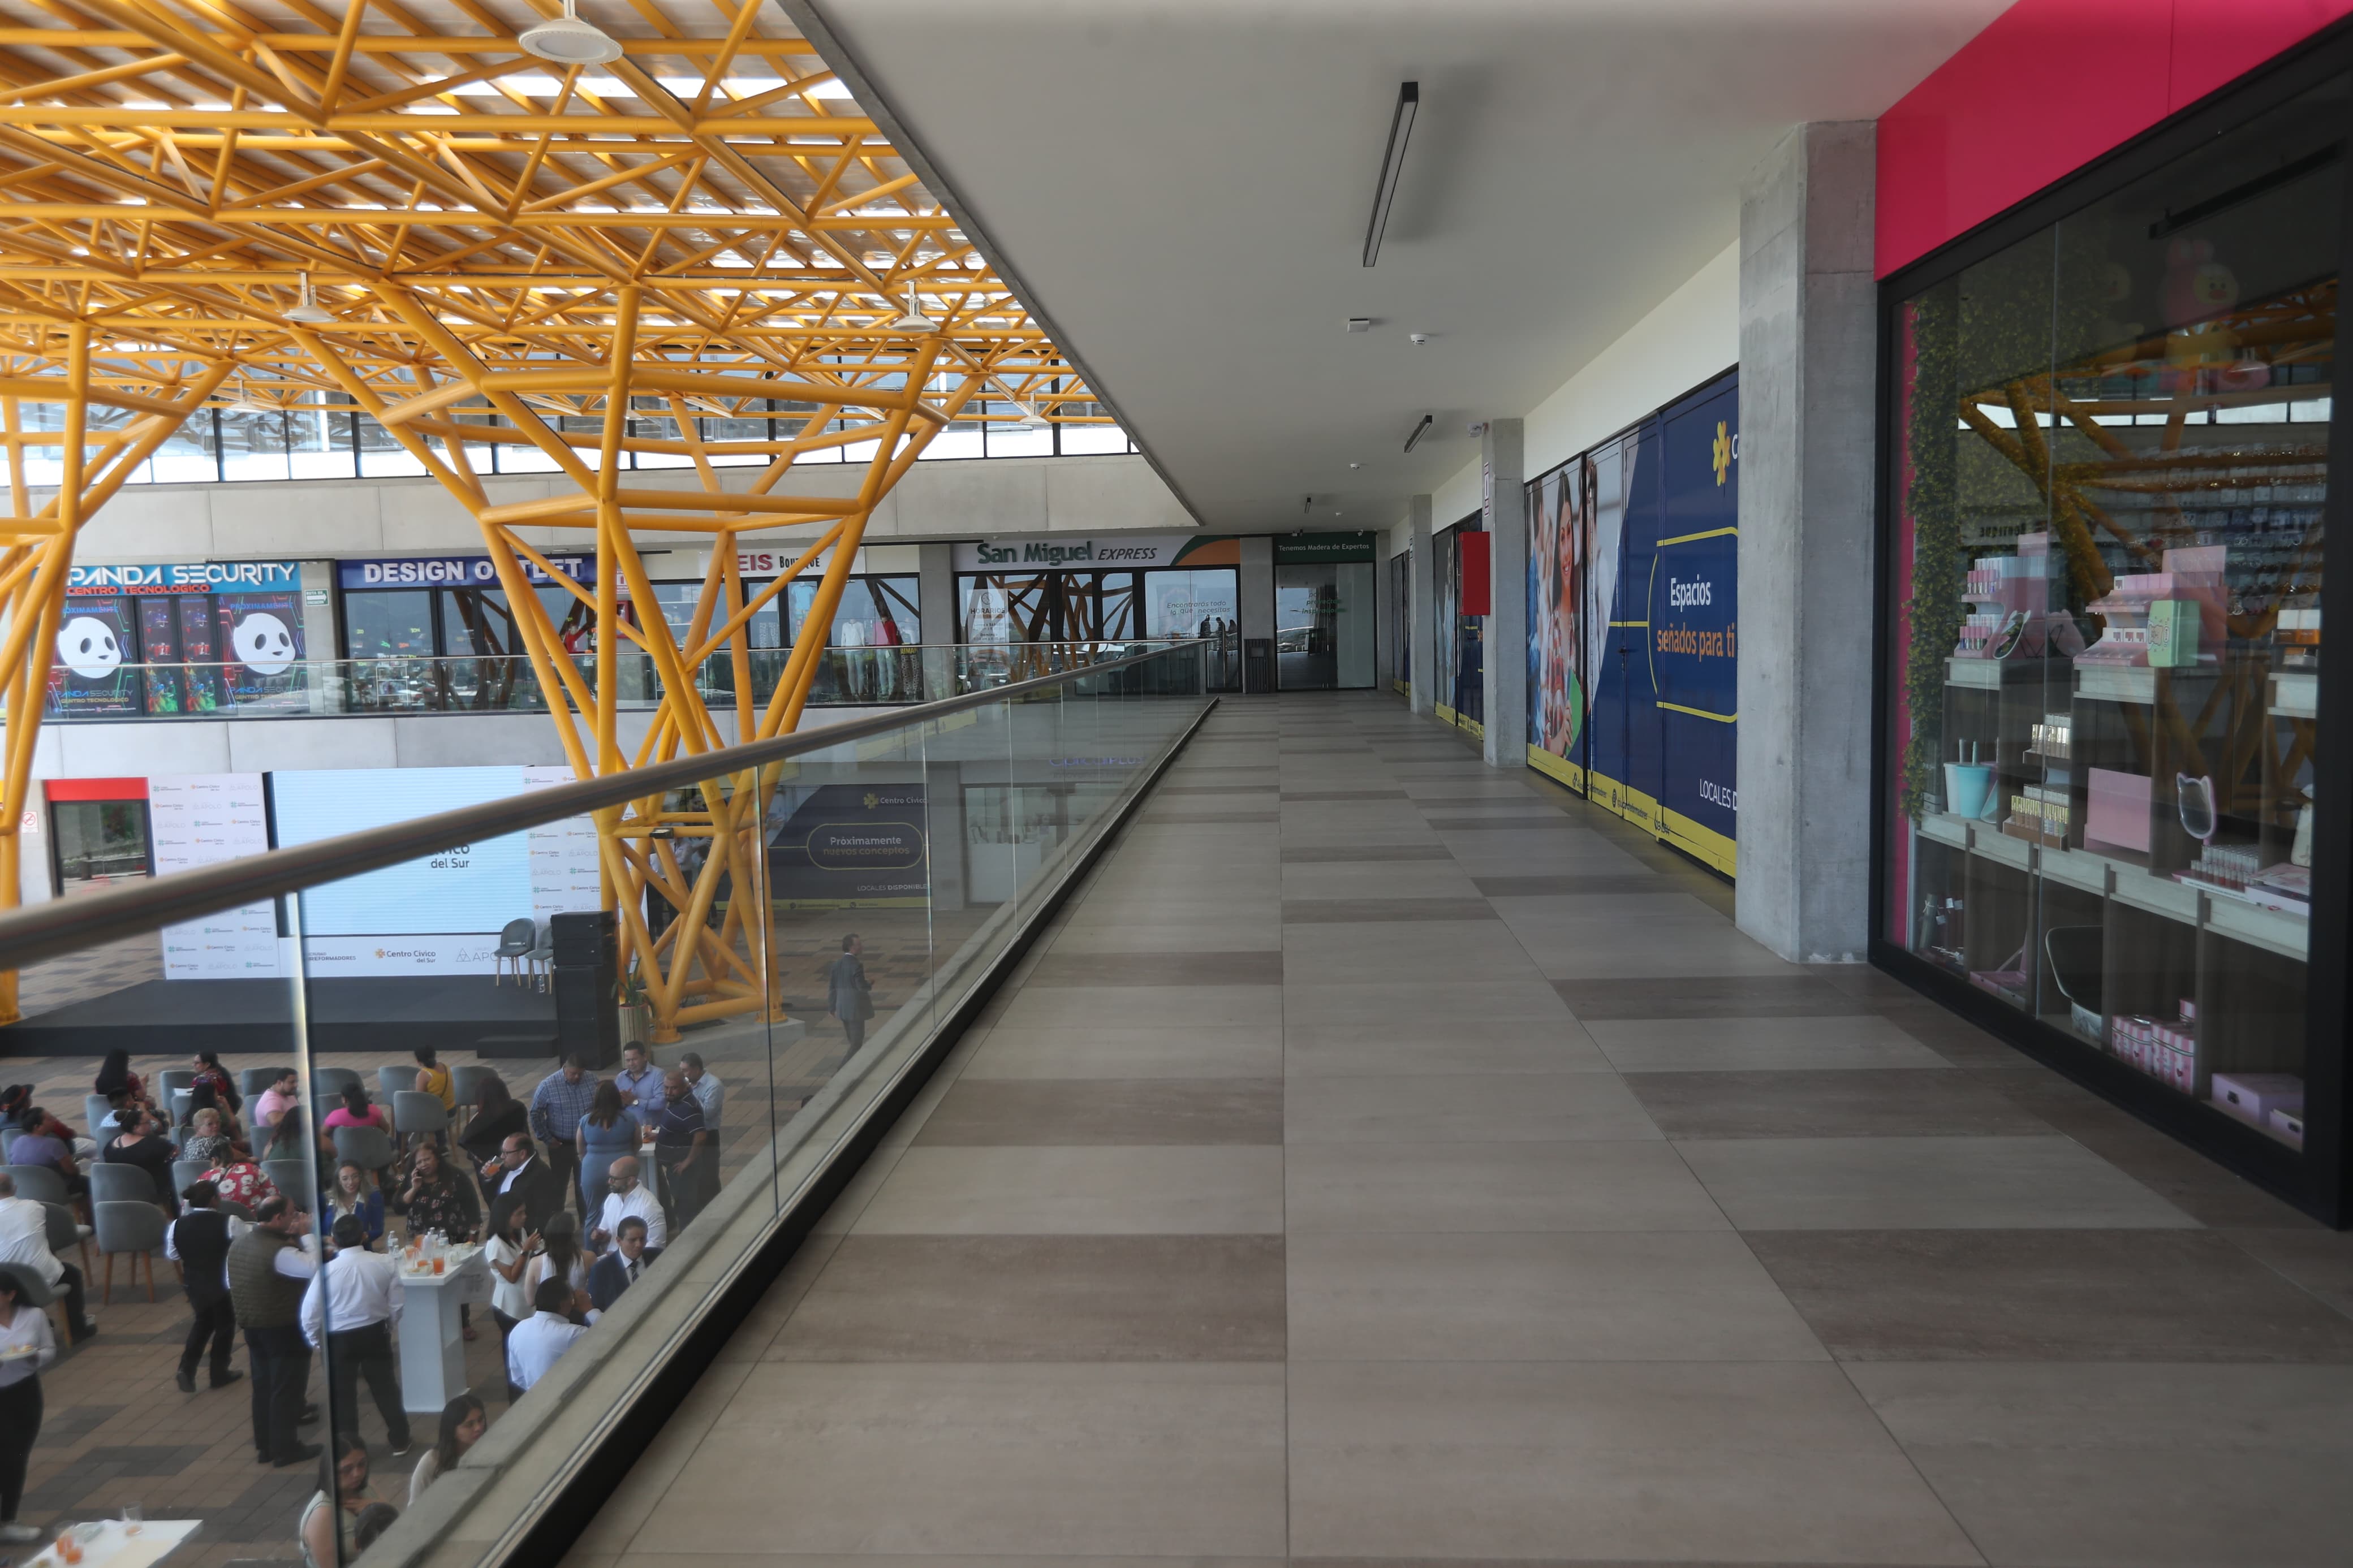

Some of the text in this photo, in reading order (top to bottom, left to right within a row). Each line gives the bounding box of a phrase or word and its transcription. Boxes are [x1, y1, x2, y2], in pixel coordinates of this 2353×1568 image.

[977, 541, 1157, 566] San Miguel EXPRESS
[68, 563, 294, 585] PANDA SECURITY
[364, 561, 465, 583] DESIGN
[67, 584, 211, 595] CENTRO TECNOLOGICO
[1670, 574, 1711, 612] Espacios
[1699, 630, 1723, 663] para
[1727, 622, 1735, 658] ti
[1700, 778, 1731, 809] LOCALES
[830, 837, 902, 845] Próximamente
[859, 846, 910, 856] conceptos
[431, 858, 470, 869] del Sur
